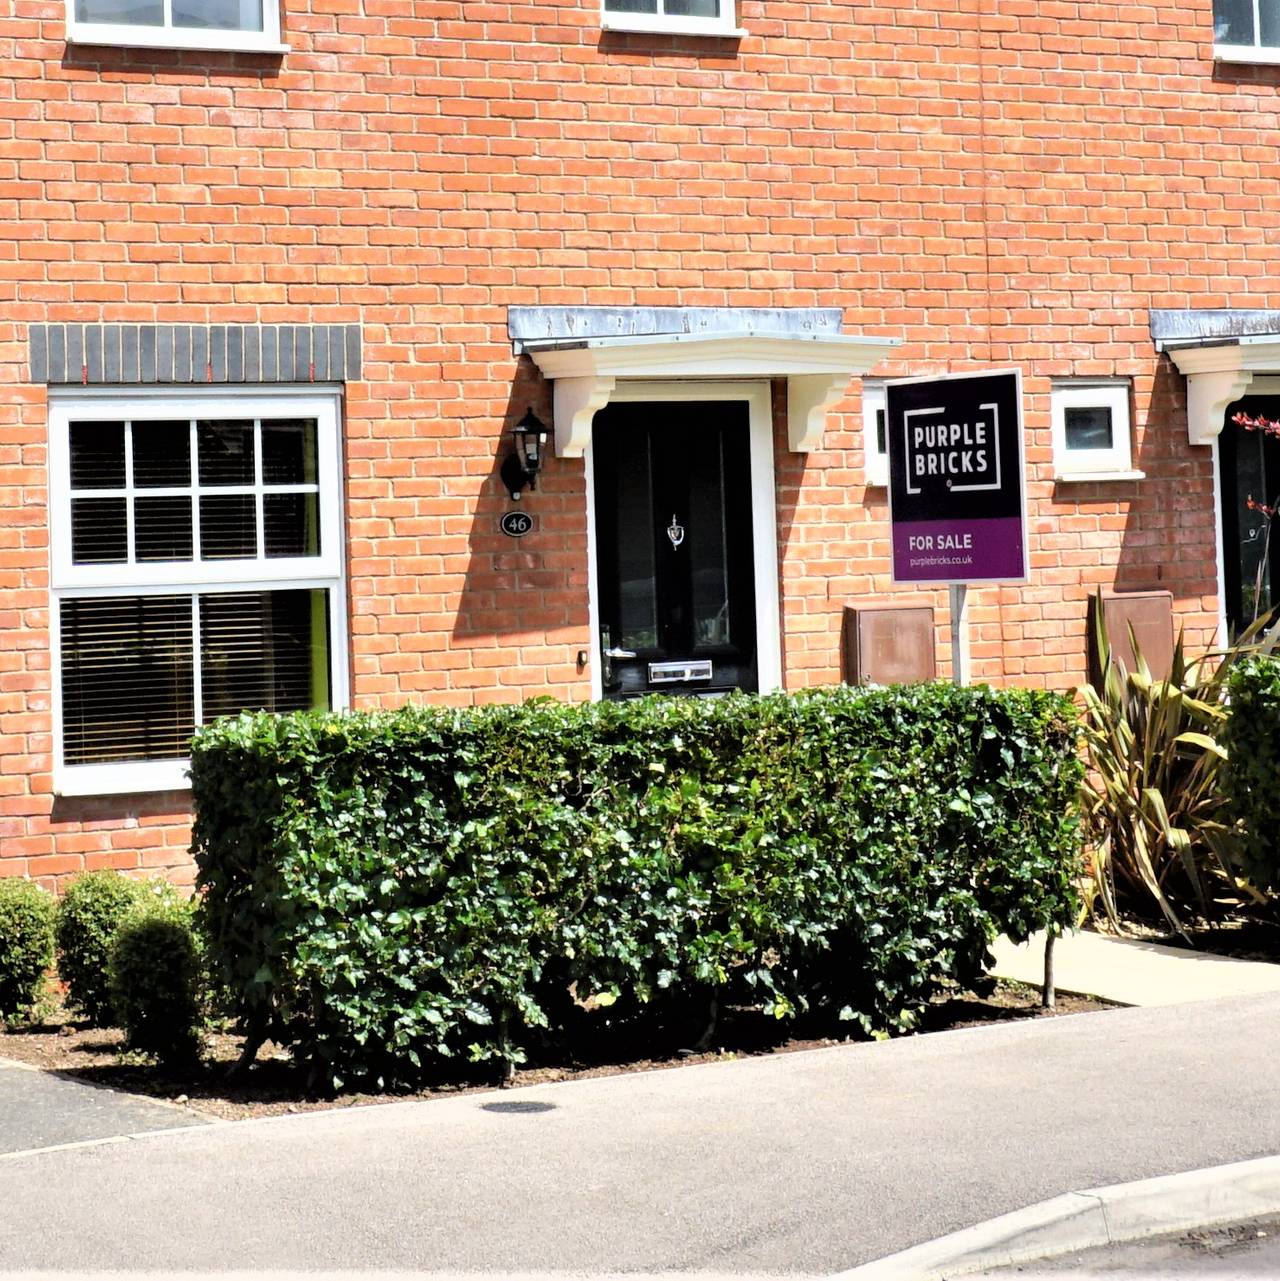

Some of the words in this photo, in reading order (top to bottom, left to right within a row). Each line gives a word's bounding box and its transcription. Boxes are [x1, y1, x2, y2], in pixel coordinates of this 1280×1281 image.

[914, 422, 987, 448] PURPLE
[915, 450, 988, 475] BRICKS
[509, 517, 527, 531] 46
[909, 536, 933, 550] FOR
[937, 534, 972, 550] SALE
[910, 555, 973, 568] purplebricks.co.uk
